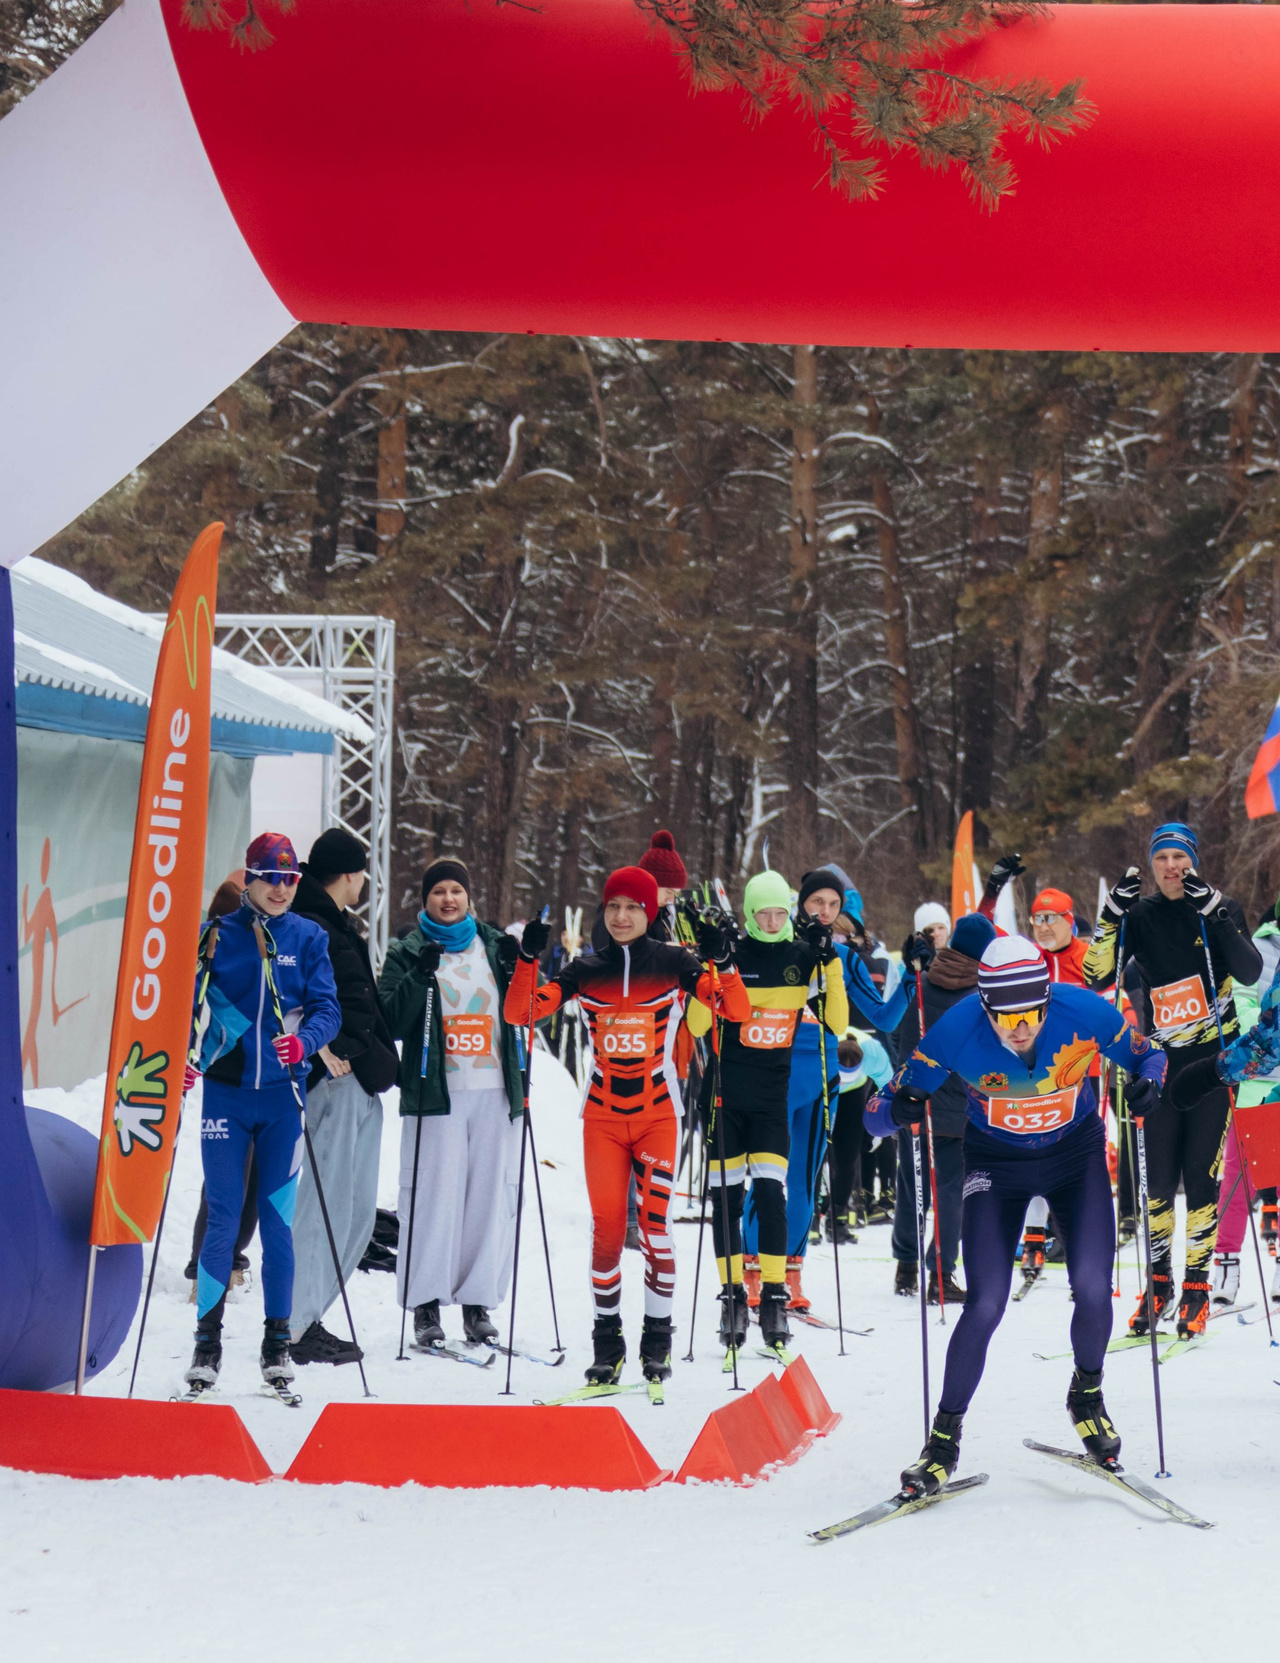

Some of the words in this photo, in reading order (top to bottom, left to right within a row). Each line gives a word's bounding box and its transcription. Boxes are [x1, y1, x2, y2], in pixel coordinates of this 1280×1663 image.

[131, 708, 192, 1021] Goodline
[1165, 984, 1193, 997] Goodline
[763, 1012, 790, 1020] Goodline
[1160, 998, 1201, 1024] 040
[457, 1018, 484, 1026] Goodline
[614, 1017, 645, 1025] Goodline
[446, 1033, 485, 1051] 059
[604, 1034, 647, 1053] 035
[748, 1026, 788, 1044] 036
[1022, 1097, 1062, 1109] Goodline
[1003, 1109, 1062, 1129] 032
[640, 1151, 658, 1165] Easy
[659, 1160, 672, 1169] ski
